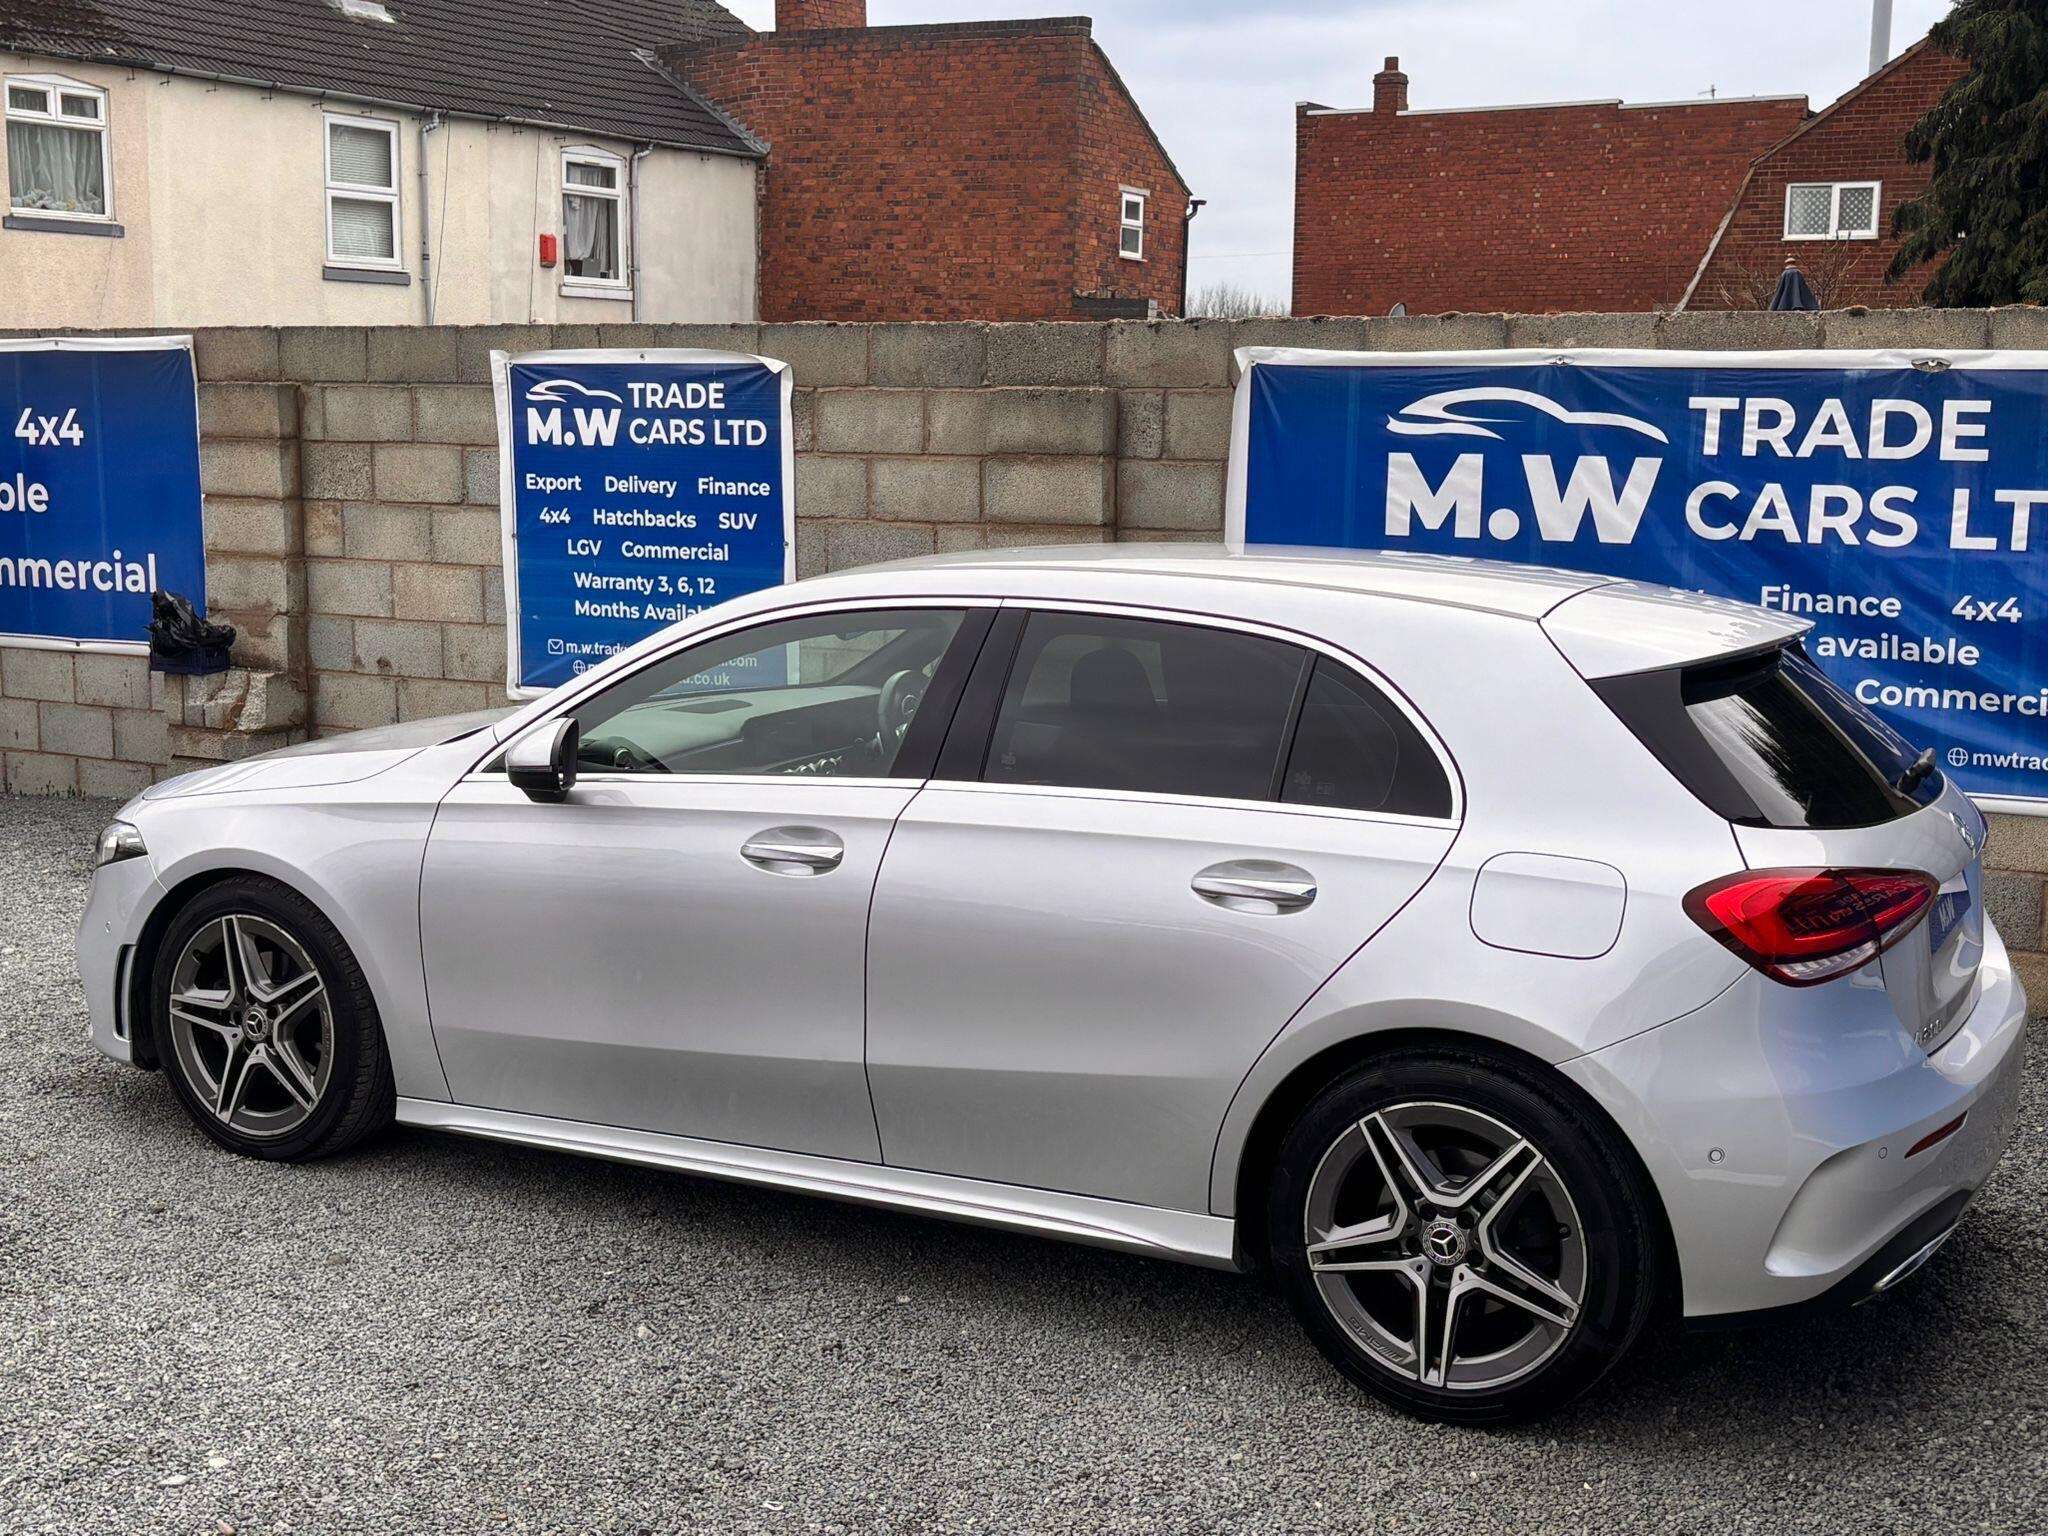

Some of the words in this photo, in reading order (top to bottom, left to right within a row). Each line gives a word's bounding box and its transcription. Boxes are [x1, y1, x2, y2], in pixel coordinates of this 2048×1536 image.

[628, 383, 725, 409] TRADE
[15, 407, 84, 446] 4x4
[527, 407, 622, 446] M.W
[629, 418, 706, 445] CARS
[713, 420, 767, 446] LTD
[1689, 396, 1992, 462] TRADE
[526, 473, 582, 493] Export
[605, 476, 677, 498] Delivery
[698, 477, 770, 496] Finance
[1385, 453, 1663, 545] M.W
[539, 507, 571, 524] 4x4
[593, 509, 697, 529] Hatchbacks
[718, 512, 758, 530] SUV
[1685, 481, 1918, 548] CARS
[567, 539, 602, 556] LGV
[621, 541, 729, 561] Commercial
[574, 572, 654, 595] Warranty
[658, 578, 673, 596] 3,
[678, 579, 694, 596] 6,
[697, 580, 715, 595] 12
[575, 600, 640, 619] Months
[1761, 584, 1902, 618] Finance
[1951, 595, 2022, 623] 4x4
[1816, 633, 1980, 666] available
